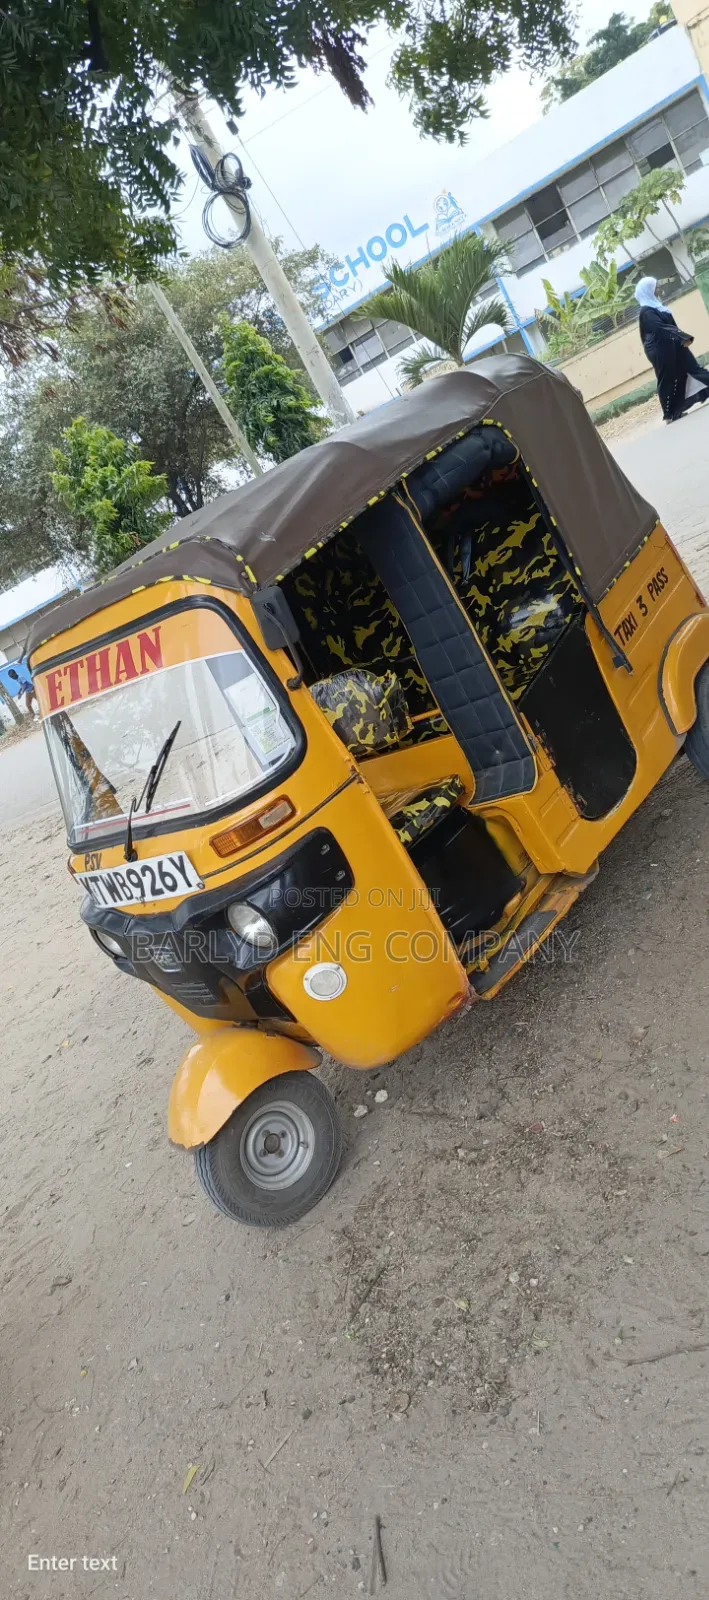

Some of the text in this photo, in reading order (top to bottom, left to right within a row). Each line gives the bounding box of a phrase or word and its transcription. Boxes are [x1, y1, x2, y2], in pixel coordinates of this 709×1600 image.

[614, 567, 668, 646] TAXI 3 PASS
[45, 625, 163, 712] ETHAN
